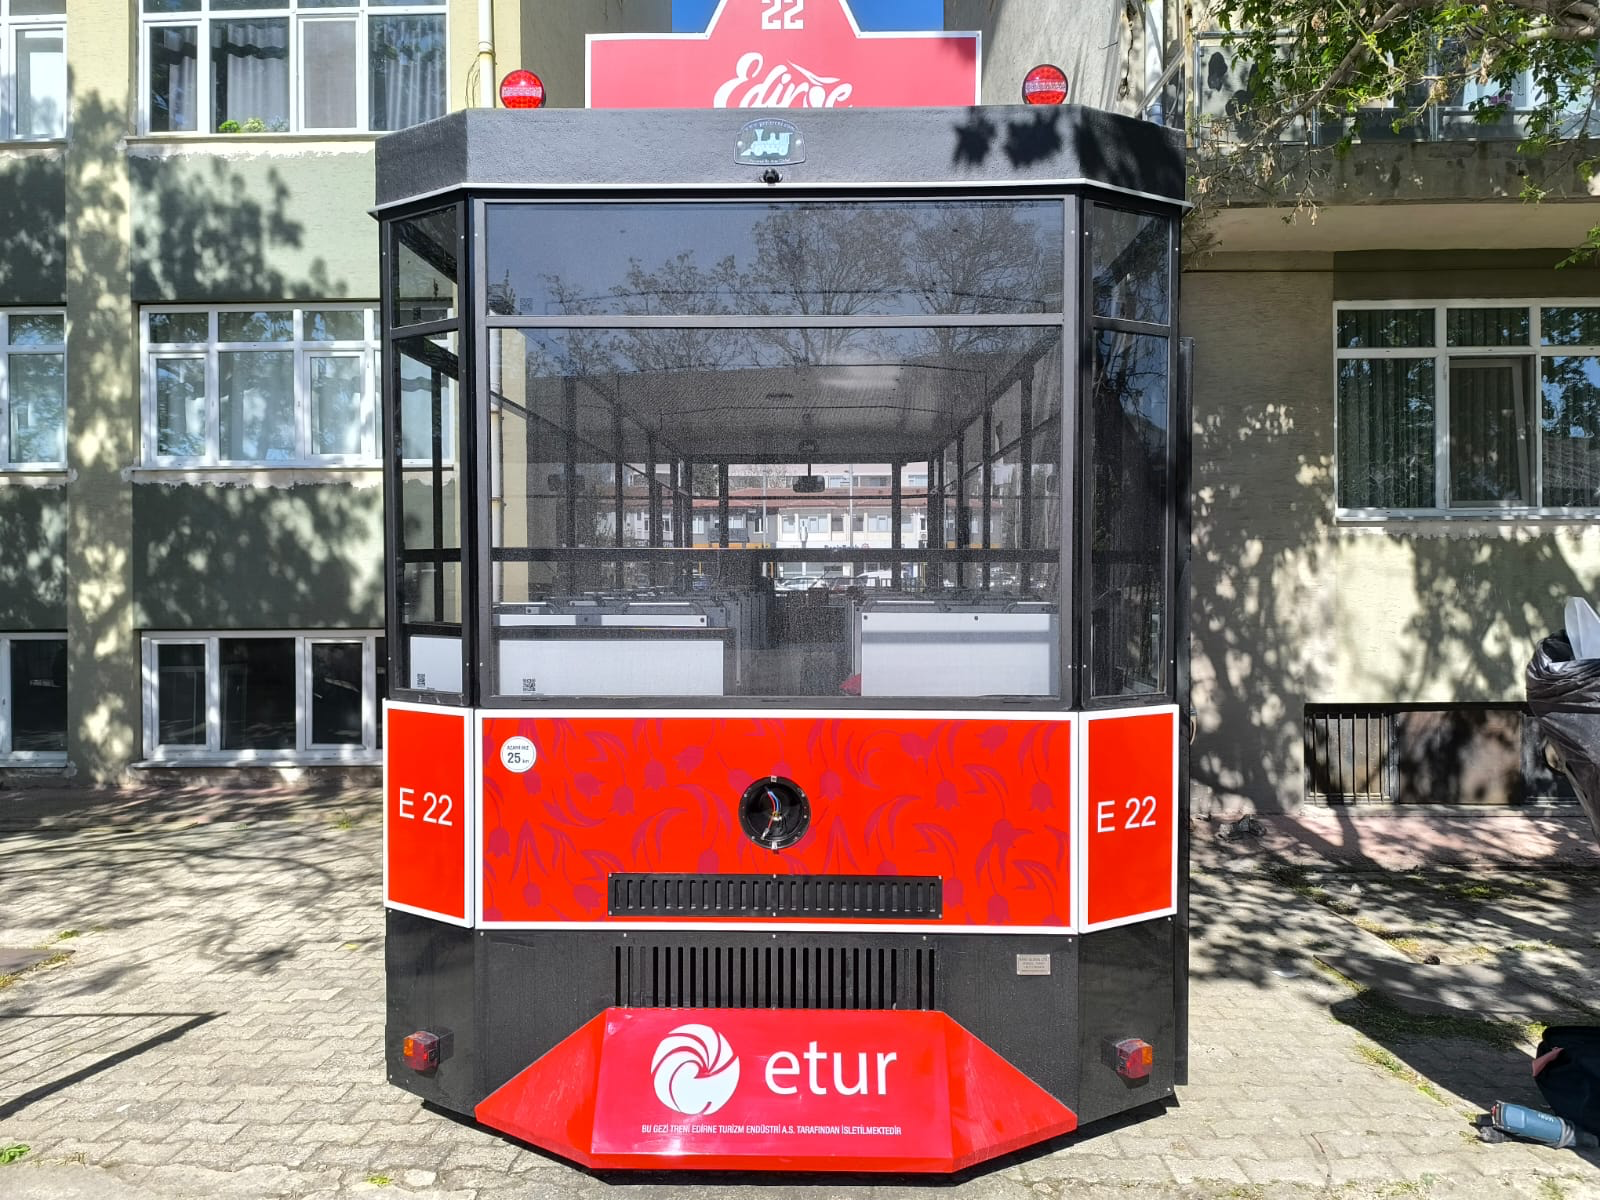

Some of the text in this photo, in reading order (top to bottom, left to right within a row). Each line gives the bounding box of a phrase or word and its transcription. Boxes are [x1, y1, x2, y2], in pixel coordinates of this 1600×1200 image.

[761, 0, 804, 30] 22
[507, 752, 521, 764] 25
[399, 786, 453, 827] E 22
[1097, 795, 1157, 833] E 22
[764, 1041, 898, 1096] etur
[641, 1123, 652, 1134] BU
[796, 1124, 841, 1135] TARAFINDAN
